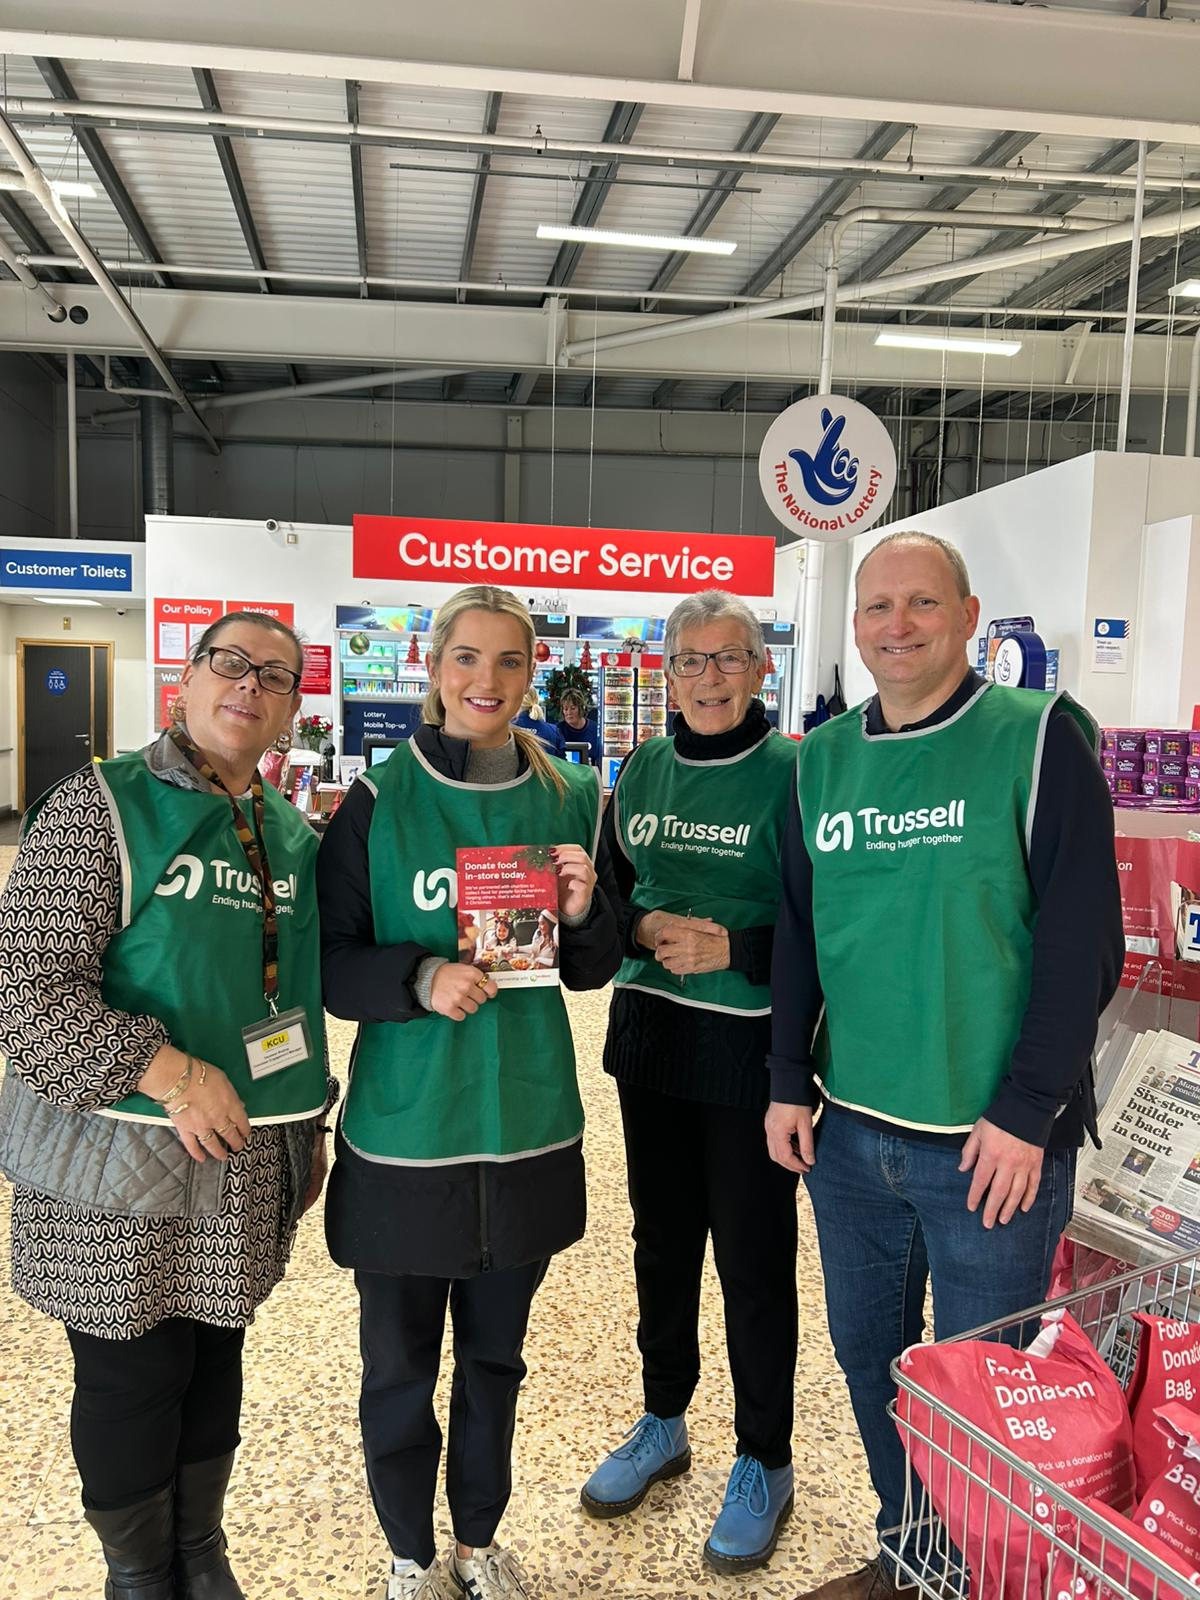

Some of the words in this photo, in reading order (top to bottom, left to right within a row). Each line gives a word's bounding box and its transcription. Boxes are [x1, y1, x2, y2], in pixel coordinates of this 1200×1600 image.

[775, 461, 789, 494] The
[782, 494, 845, 530] National
[846, 469, 882, 524] Lottery
[399, 532, 589, 575] Customer
[598, 543, 735, 581] Service
[5, 562, 77, 576] Customer
[80, 565, 127, 578] Toilets
[162, 604, 181, 614] Our
[184, 605, 213, 616] Policy
[857, 799, 965, 835] Trussell
[662, 815, 751, 846] Trussell
[661, 841, 684, 851] Ending
[685, 843, 710, 853] hunger
[711, 847, 745, 858] together
[866, 841, 896, 851] Ending
[922, 833, 963, 846] together
[465, 872, 500, 880] in-store
[501, 871, 527, 880] today.
[497, 861, 517, 869] food
[210, 859, 297, 901] Trusel
[212, 894, 240, 909] Ending
[267, 1035, 285, 1048] KCU
[1127, 1097, 1183, 1129] builder
[1119, 1110, 1133, 1123] is
[1134, 1116, 1172, 1140] back
[1111, 1122, 1128, 1137] in
[1130, 1133, 1173, 1156] court
[1156, 1321, 1189, 1341] Food
[1165, 1379, 1196, 1400] Bag.
[1005, 1416, 1057, 1440] Bag.
[1038, 1461, 1054, 1471] Pick
[1055, 1461, 1065, 1470] up
[1072, 1453, 1103, 1466] donation
[1166, 1510, 1185, 1528] Pick
[1186, 1523, 1198, 1535] up
[1160, 1528, 1184, 1550] When
